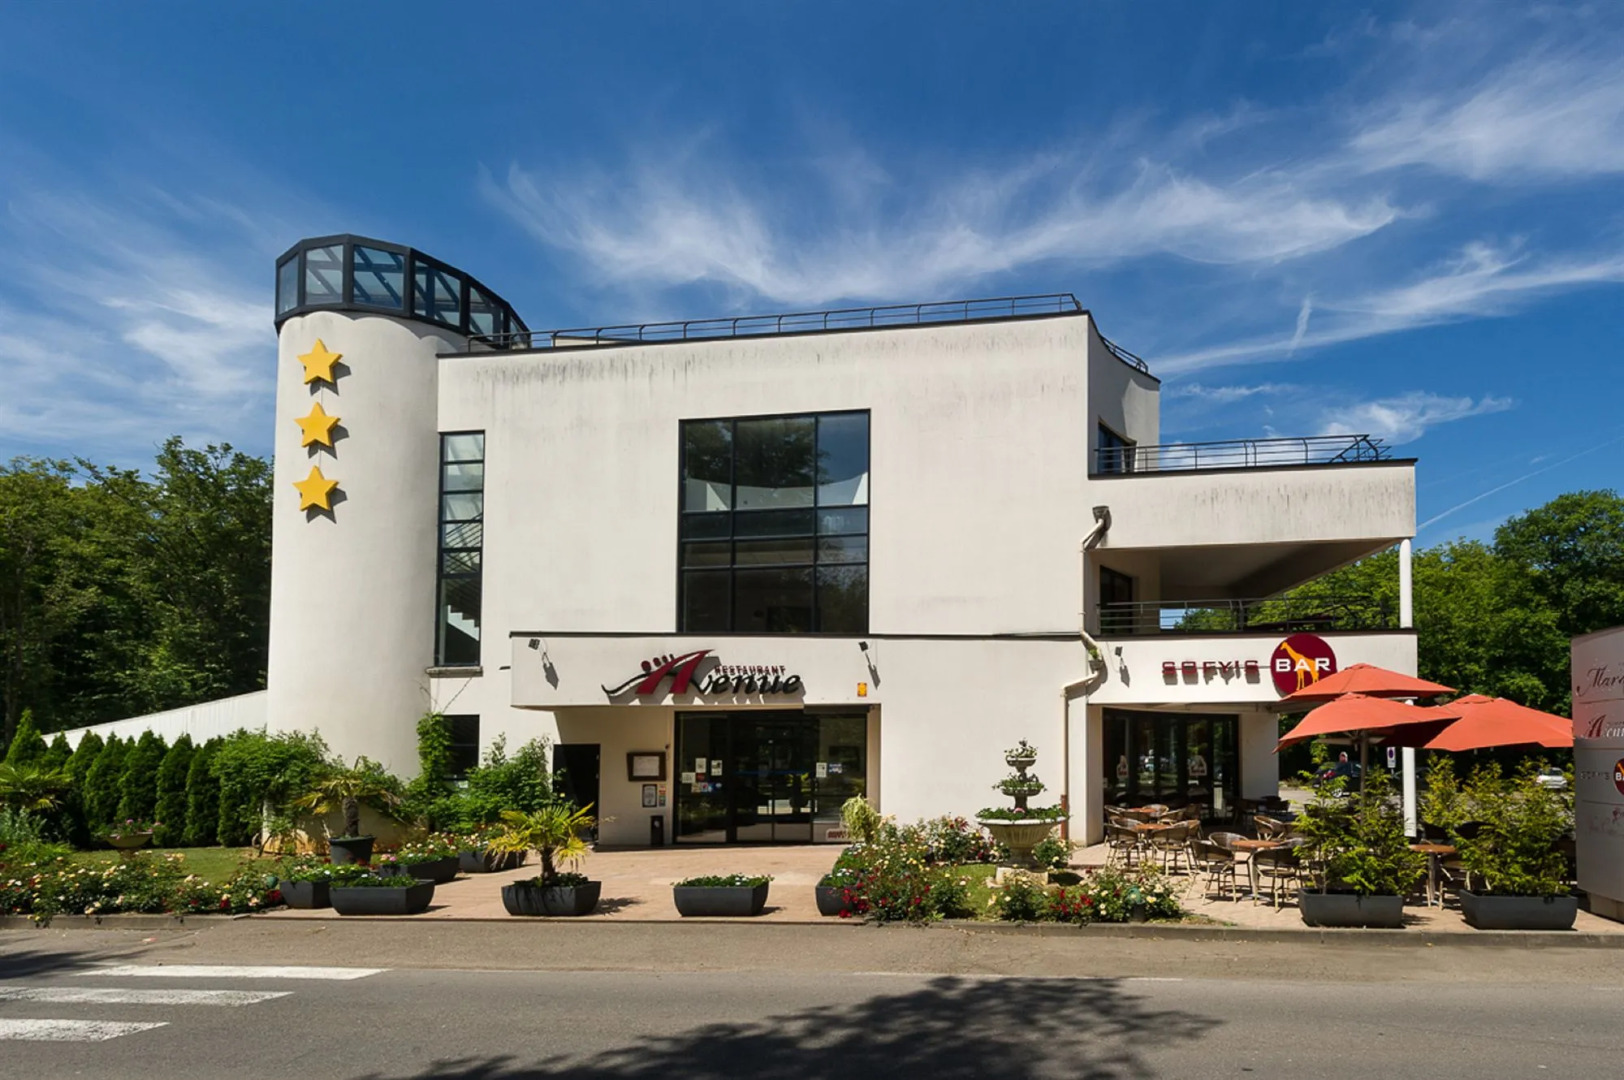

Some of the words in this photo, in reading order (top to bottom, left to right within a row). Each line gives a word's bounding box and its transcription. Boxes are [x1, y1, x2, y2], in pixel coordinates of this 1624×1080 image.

[601, 649, 801, 695] Avenue
[714, 665, 786, 676] RESTAURANT
[1275, 657, 1332, 673] BAR
